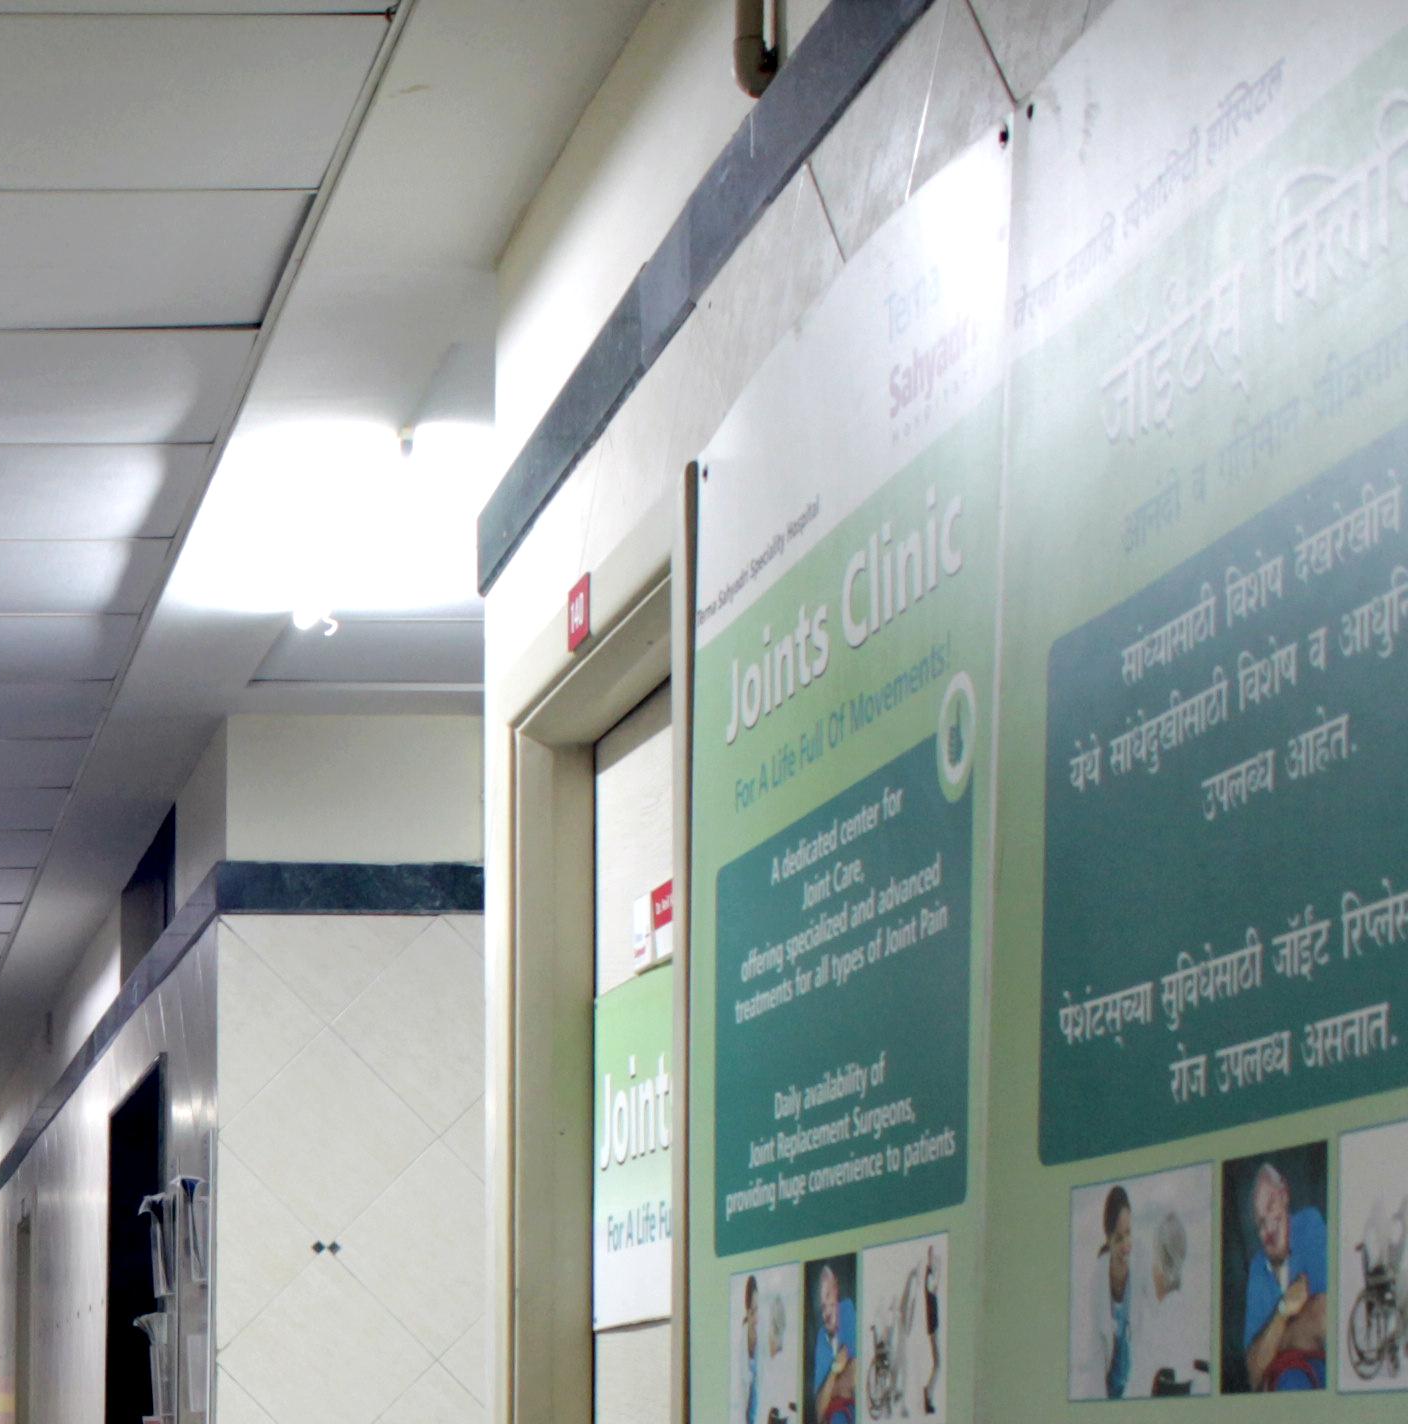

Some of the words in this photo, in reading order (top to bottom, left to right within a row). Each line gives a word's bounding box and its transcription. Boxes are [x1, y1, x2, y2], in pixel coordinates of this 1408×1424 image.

[724, 602, 829, 746] Joints
[840, 485, 965, 650] Clinic
[1238, 636, 1298, 711] विशेष
[1308, 627, 1328, 671] व
[735, 774, 754, 812] For
[759, 757, 770, 794] A
[771, 738, 796, 786] Life
[798, 717, 824, 773] Full
[827, 704, 847, 750] Of
[848, 630, 953, 736] Movements!
[771, 857, 781, 885] A
[782, 819, 838, 878] dedicated
[840, 803, 880, 845] center
[882, 786, 904, 820] for
[741, 942, 785, 983] offering
[786, 902, 849, 966] specialized
[850, 887, 877, 929] and
[878, 852, 943, 914] advanced
[802, 870, 832, 910] Joint
[735, 978, 794, 1025] treatments
[795, 968, 814, 997] for
[814, 954, 832, 989] all
[832, 945, 866, 987] types
[868, 928, 882, 963] of
[884, 918, 919, 957] Joint
[920, 901, 950, 940] Pain
[774, 1084, 802, 1120] Daily
[804, 1061, 868, 1109] availability
[870, 1050, 887, 1086] of
[1216, 1031, 1292, 1094] उपलब्ध
[600, 1053, 672, 1171] Joint
[748, 1136, 776, 1169] Joint
[777, 1113, 851, 1163] Replacement
[726, 1178, 776, 1222] providing
[778, 1172, 806, 1204] huge
[808, 1152, 884, 1192] convenience
[886, 1144, 901, 1172] to
[904, 1127, 956, 1176] patients
[608, 1215, 624, 1252] For
[625, 1209, 634, 1248] A
[636, 1202, 656, 1246] Life
[659, 1200, 672, 1240] Fu
